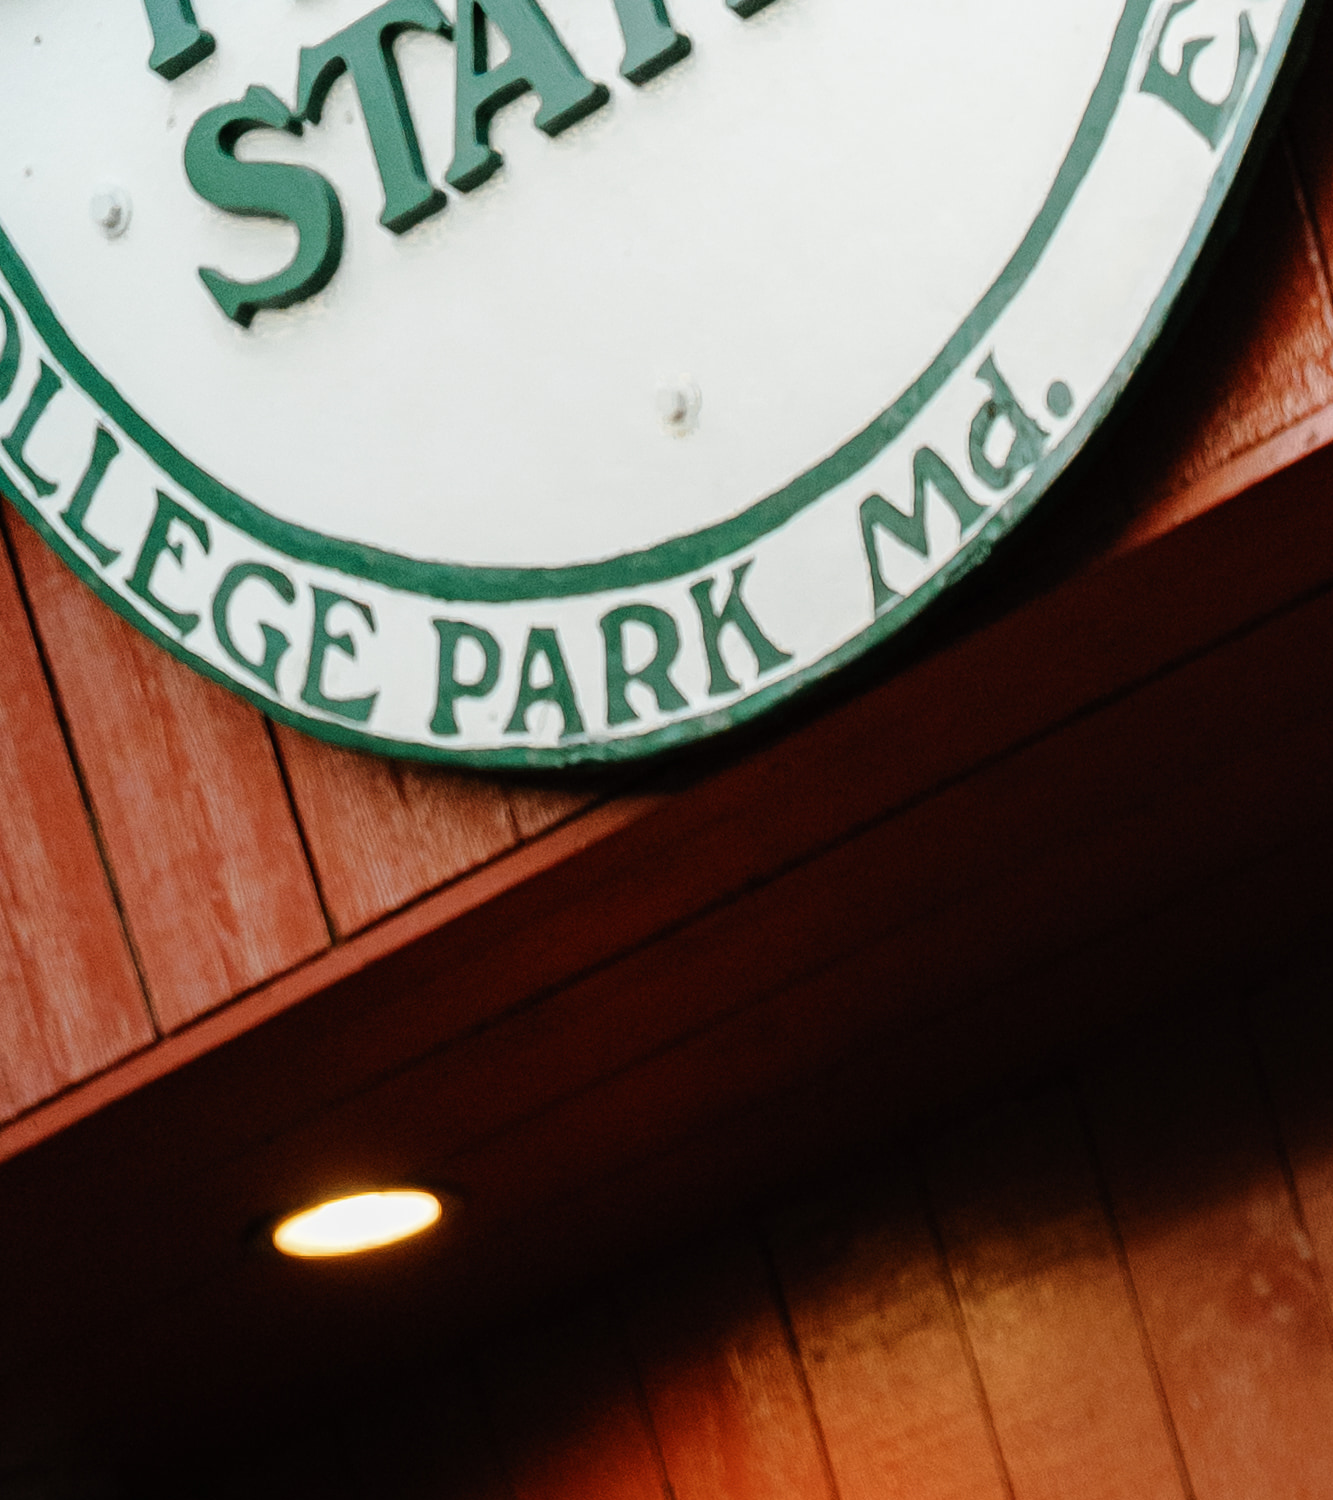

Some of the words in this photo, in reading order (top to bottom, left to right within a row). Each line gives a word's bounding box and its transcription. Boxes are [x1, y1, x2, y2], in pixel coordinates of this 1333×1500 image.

[184, 0, 785, 330] STA
[429, 560, 794, 736] PARK
[857, 353, 1078, 616] Md.
